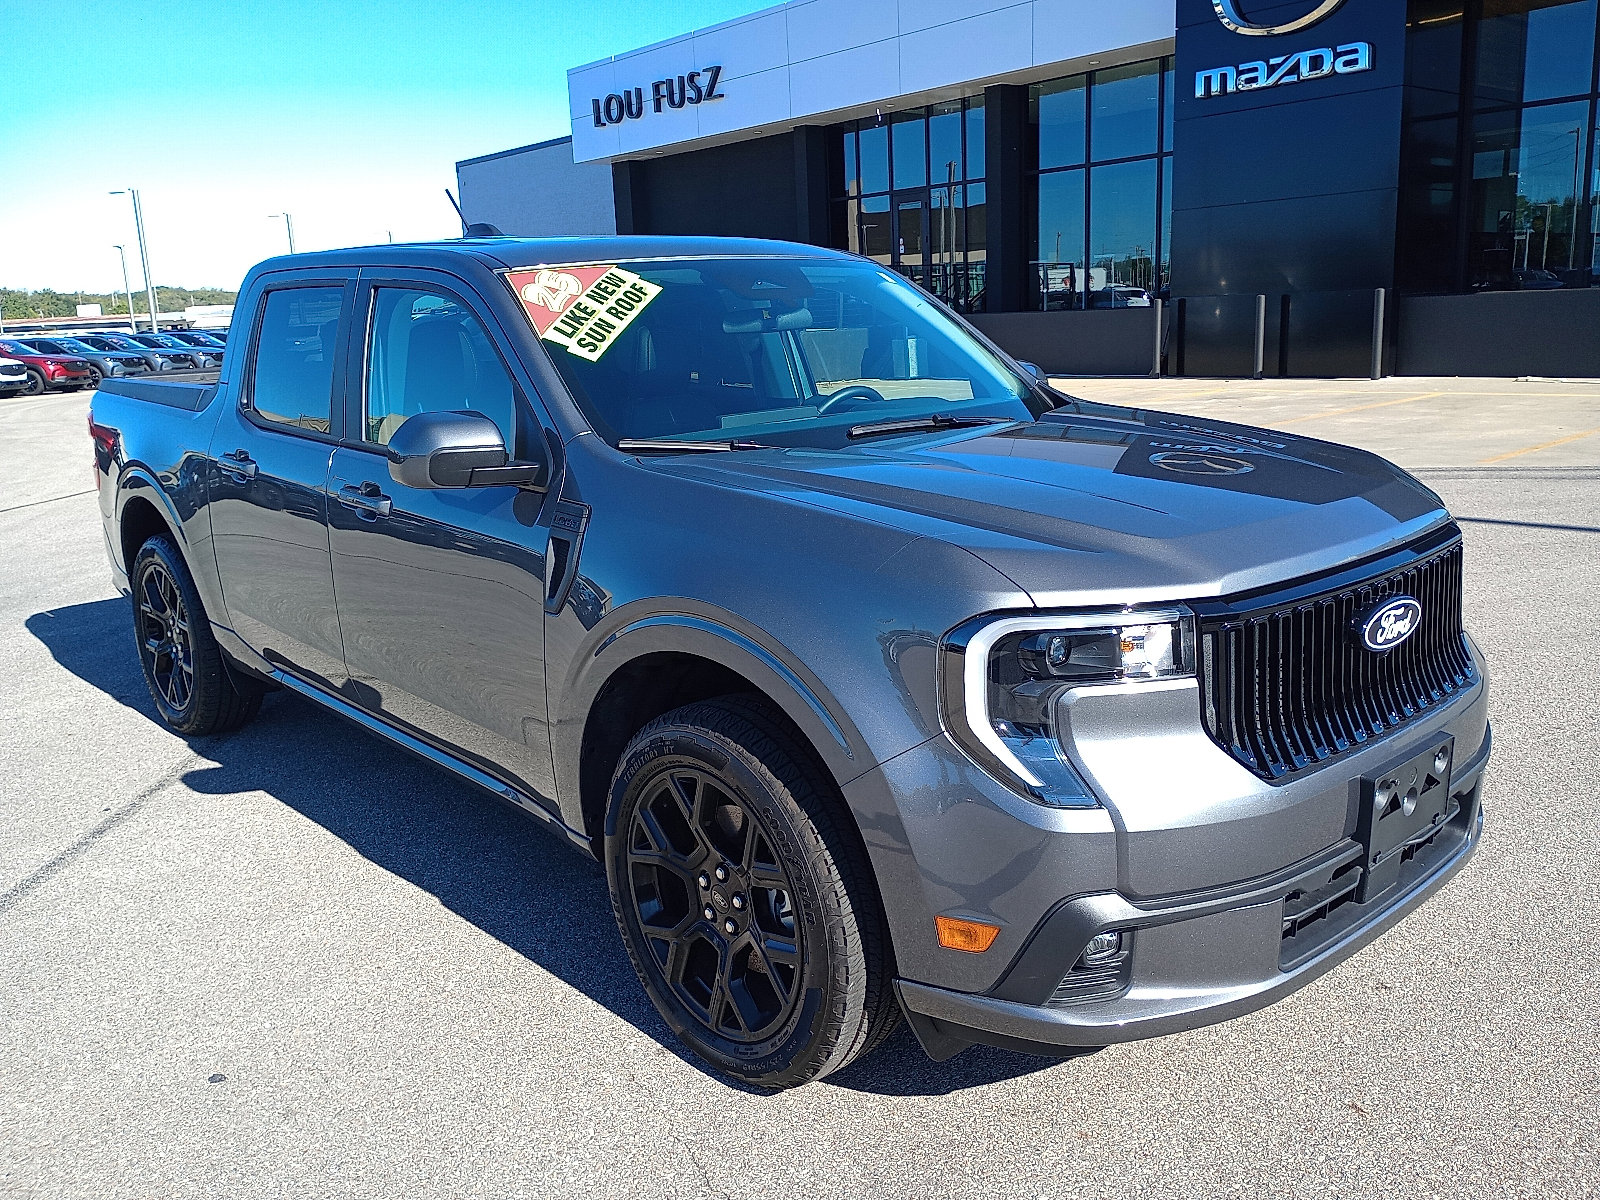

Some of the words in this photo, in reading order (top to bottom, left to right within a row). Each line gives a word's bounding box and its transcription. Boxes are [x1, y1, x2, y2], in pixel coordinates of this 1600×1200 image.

[592, 87, 644, 128] LOU
[652, 65, 725, 113] FUSZ
[521, 269, 583, 313] 25
[553, 301, 597, 340] LIKE
[585, 272, 627, 306] NEW
[576, 317, 617, 353] SUN
[605, 282, 649, 321] ROOF
[1376, 606, 1413, 644] Ford
[763, 806, 817, 926] GOODYEAR
